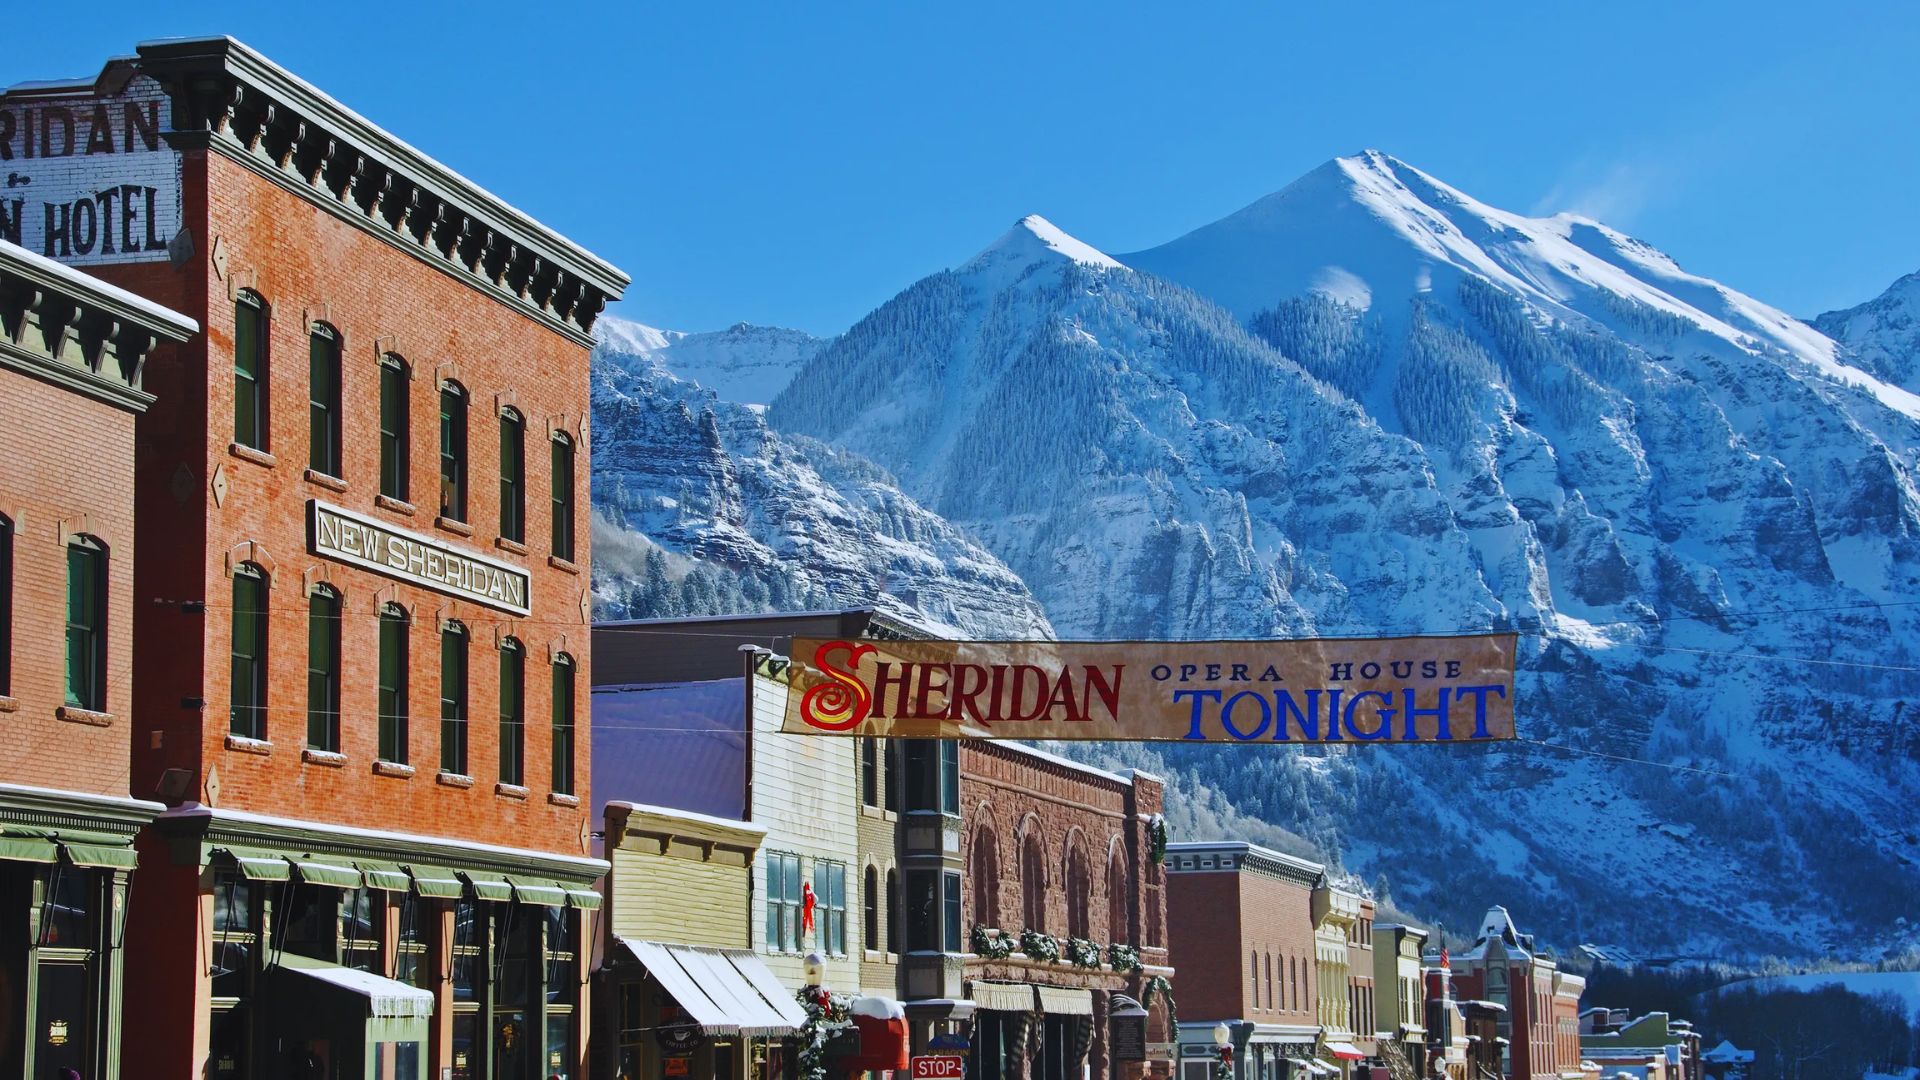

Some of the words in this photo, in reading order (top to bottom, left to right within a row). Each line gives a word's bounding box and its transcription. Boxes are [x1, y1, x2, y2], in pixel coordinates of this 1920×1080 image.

[44, 184, 167, 257] HOTEL
[319, 511, 380, 562] NEW
[800, 640, 1126, 731] SHERIDAN
[1151, 664, 1283, 682] OPERA
[1329, 661, 1461, 681] HOUSE
[1173, 685, 1506, 740] TONIGHT
[919, 1061, 956, 1076] STOP
